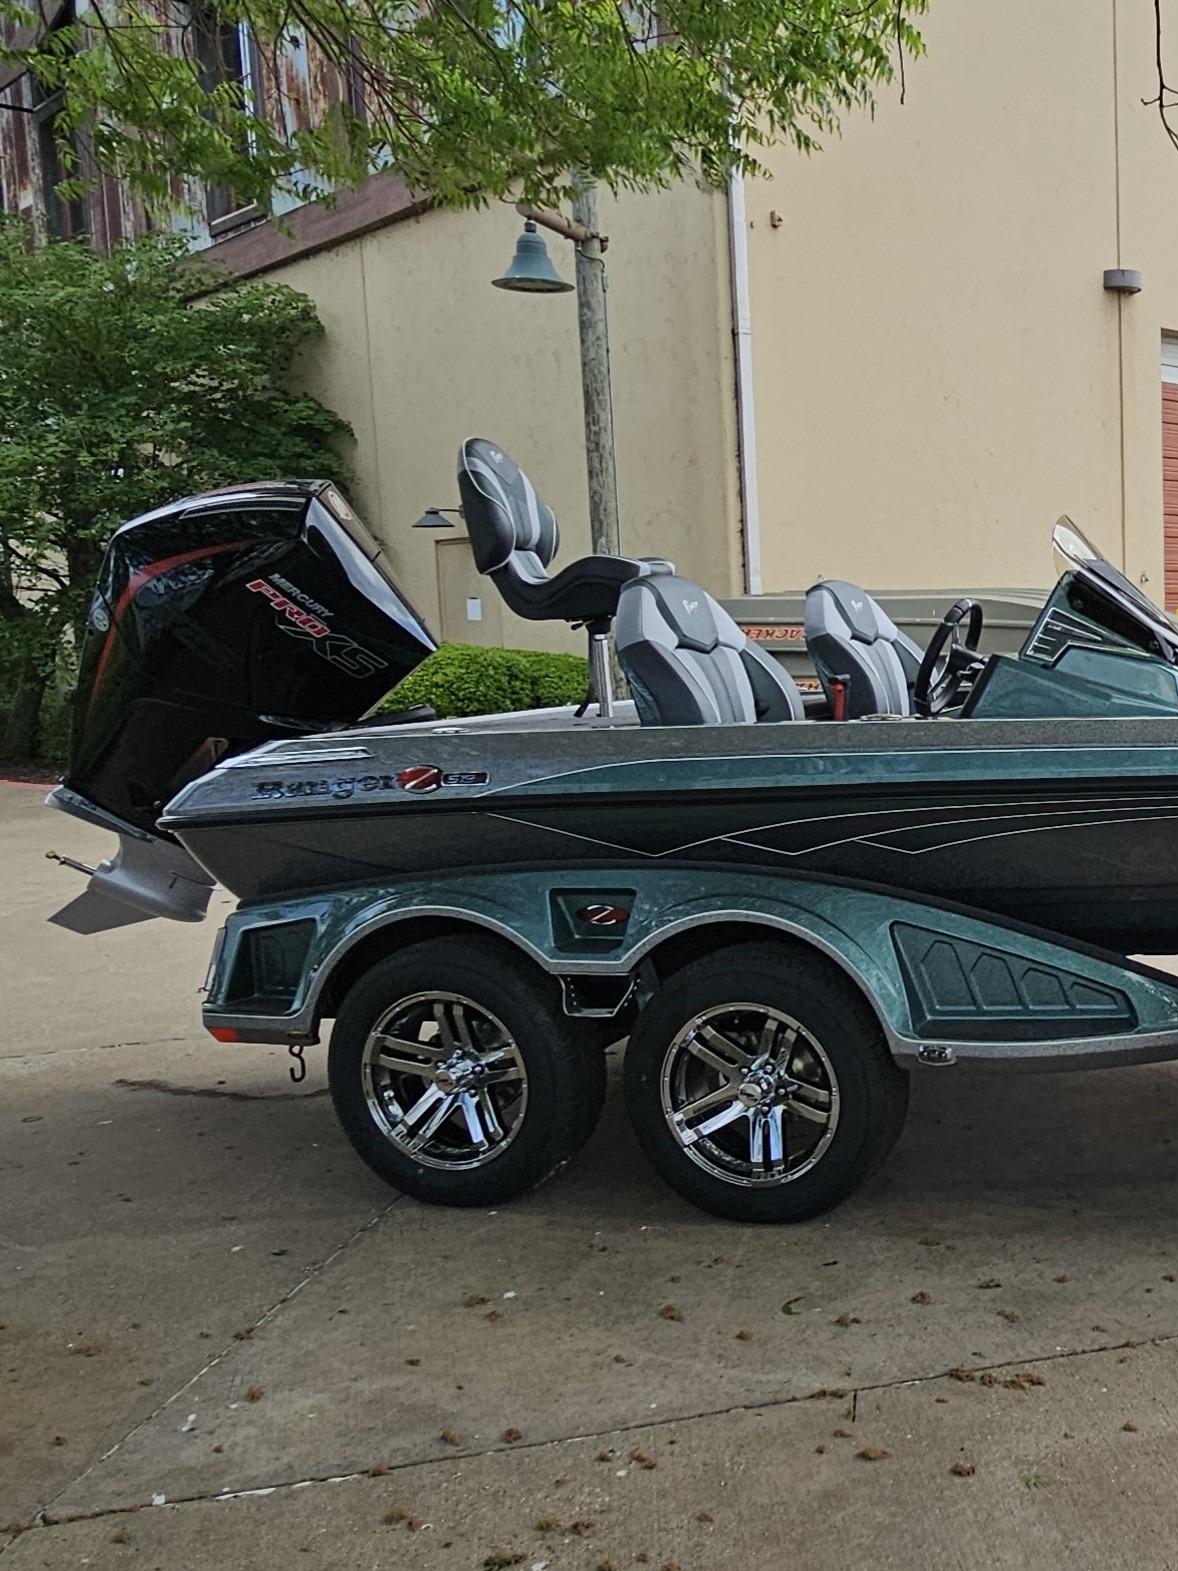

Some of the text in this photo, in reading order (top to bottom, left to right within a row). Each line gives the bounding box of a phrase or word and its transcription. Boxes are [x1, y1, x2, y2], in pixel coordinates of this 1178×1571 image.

[245, 579, 331, 638] PRO
[268, 573, 334, 617] MERCURY
[275, 612, 389, 679] XS
[251, 775, 396, 800] Ranger
